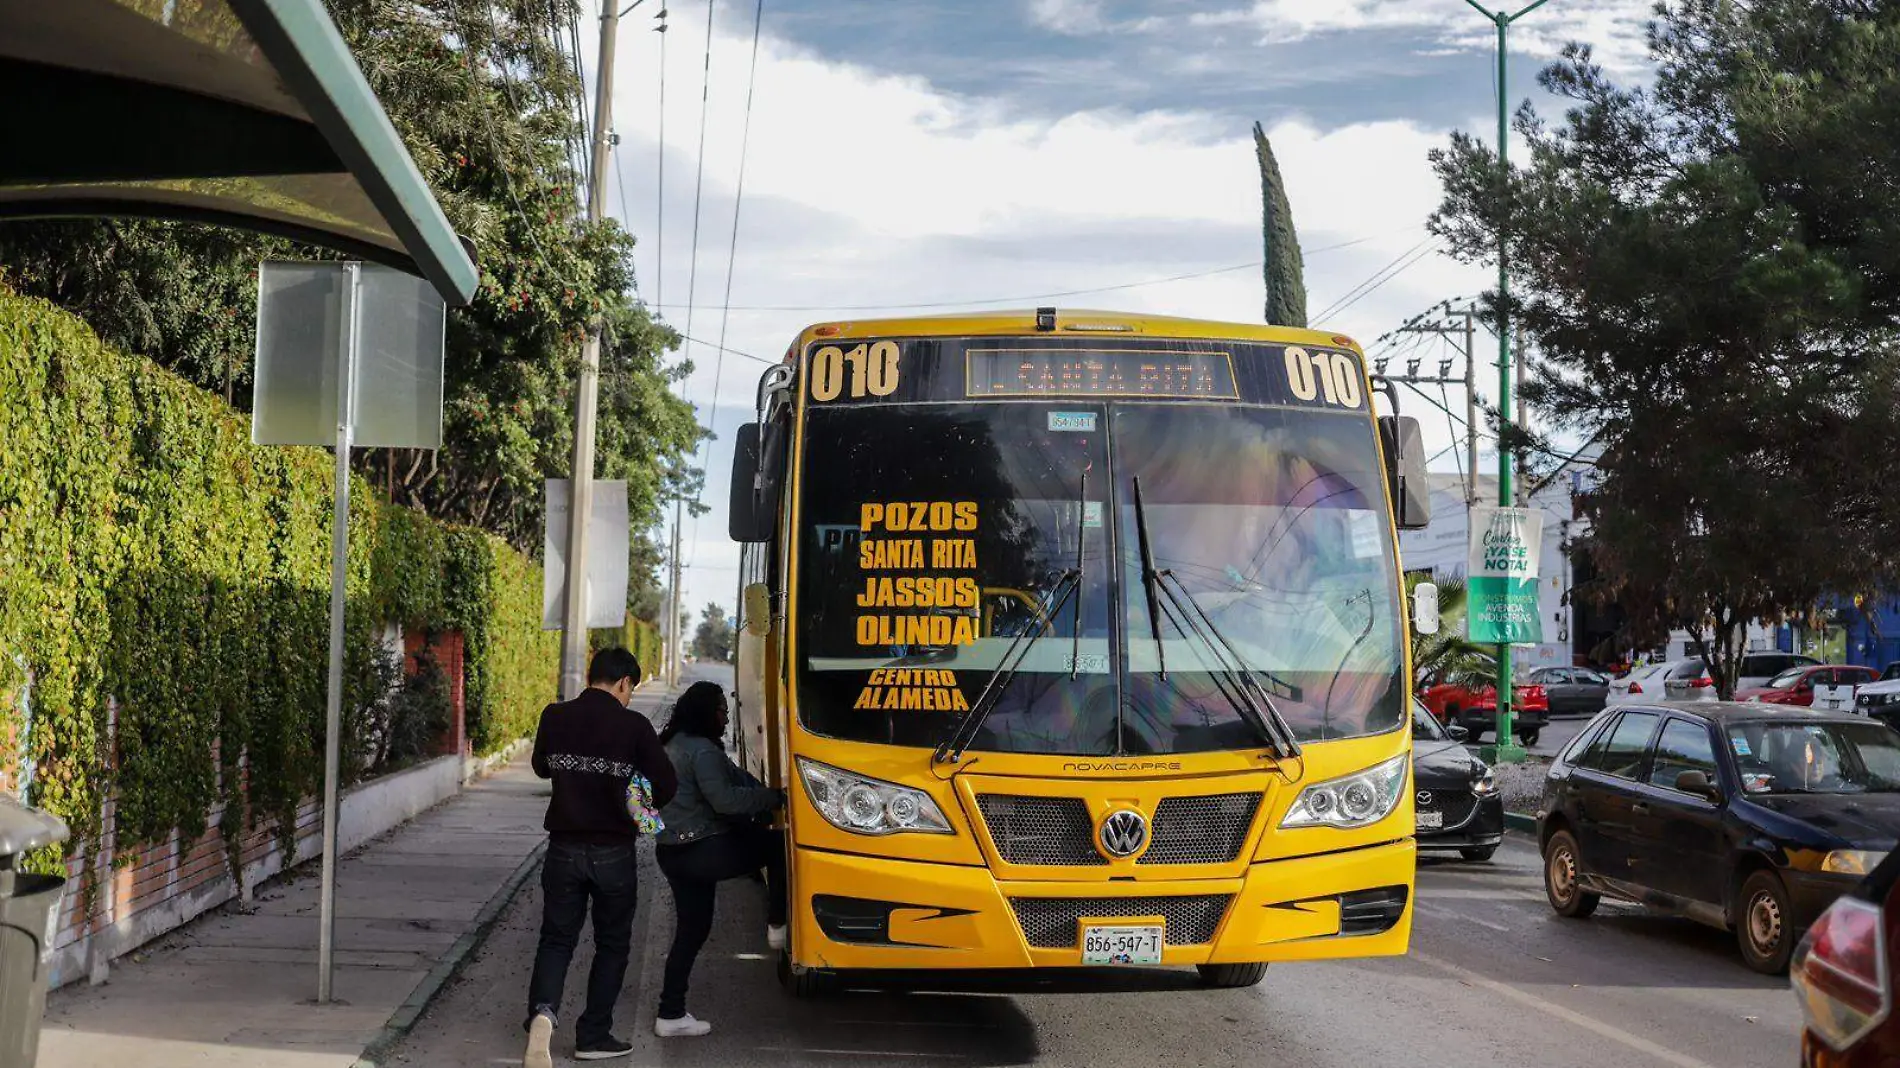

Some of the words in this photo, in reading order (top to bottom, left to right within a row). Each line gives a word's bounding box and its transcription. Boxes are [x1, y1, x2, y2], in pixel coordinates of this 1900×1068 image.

[812, 341, 900, 401] 010
[1285, 347, 1361, 408] 010
[860, 501, 978, 532] POZOS
[860, 539, 925, 569] SANTA
[932, 539, 977, 569] RITA
[857, 577, 975, 608] JASSOS
[856, 615, 974, 646] OLINDA
[868, 668, 957, 687] CENTRO
[853, 687, 970, 711] ALAMEDA
[1086, 936, 1158, 952] 856-547-T
